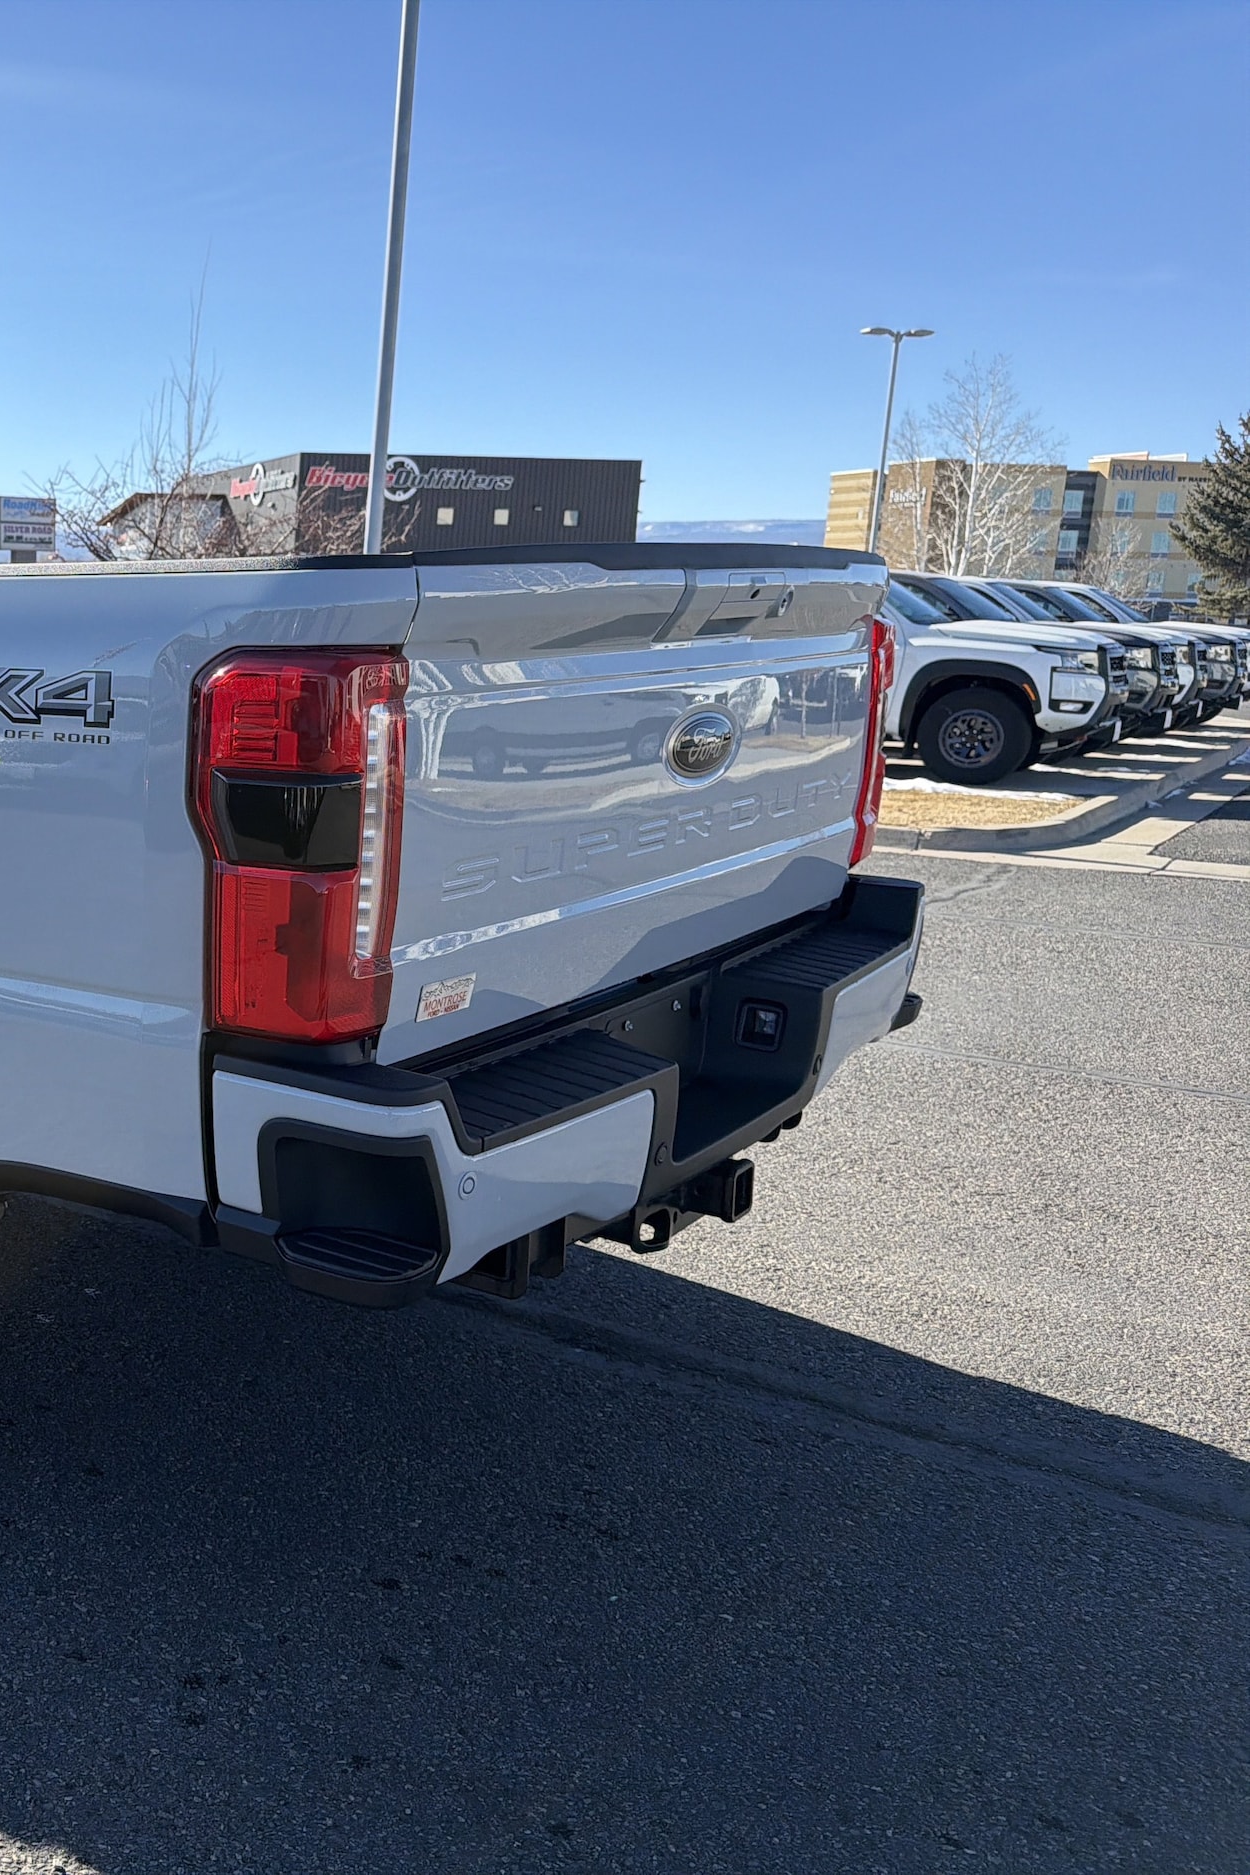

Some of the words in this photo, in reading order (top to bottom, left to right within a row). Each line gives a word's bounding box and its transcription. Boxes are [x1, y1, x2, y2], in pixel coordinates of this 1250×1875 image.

[305, 466, 395, 491] Bicyce
[393, 467, 515, 491] Outfitters
[1112, 464, 1177, 481] Fairfield
[3, 525, 30, 534] SILVER
[4, 729, 44, 740] OFF
[53, 732, 110, 745] ROAD
[688, 727, 731, 763] Ford
[441, 807, 713, 901] SUPER
[727, 771, 854, 832] DUTY
[423, 991, 468, 1012] MONTROSE
